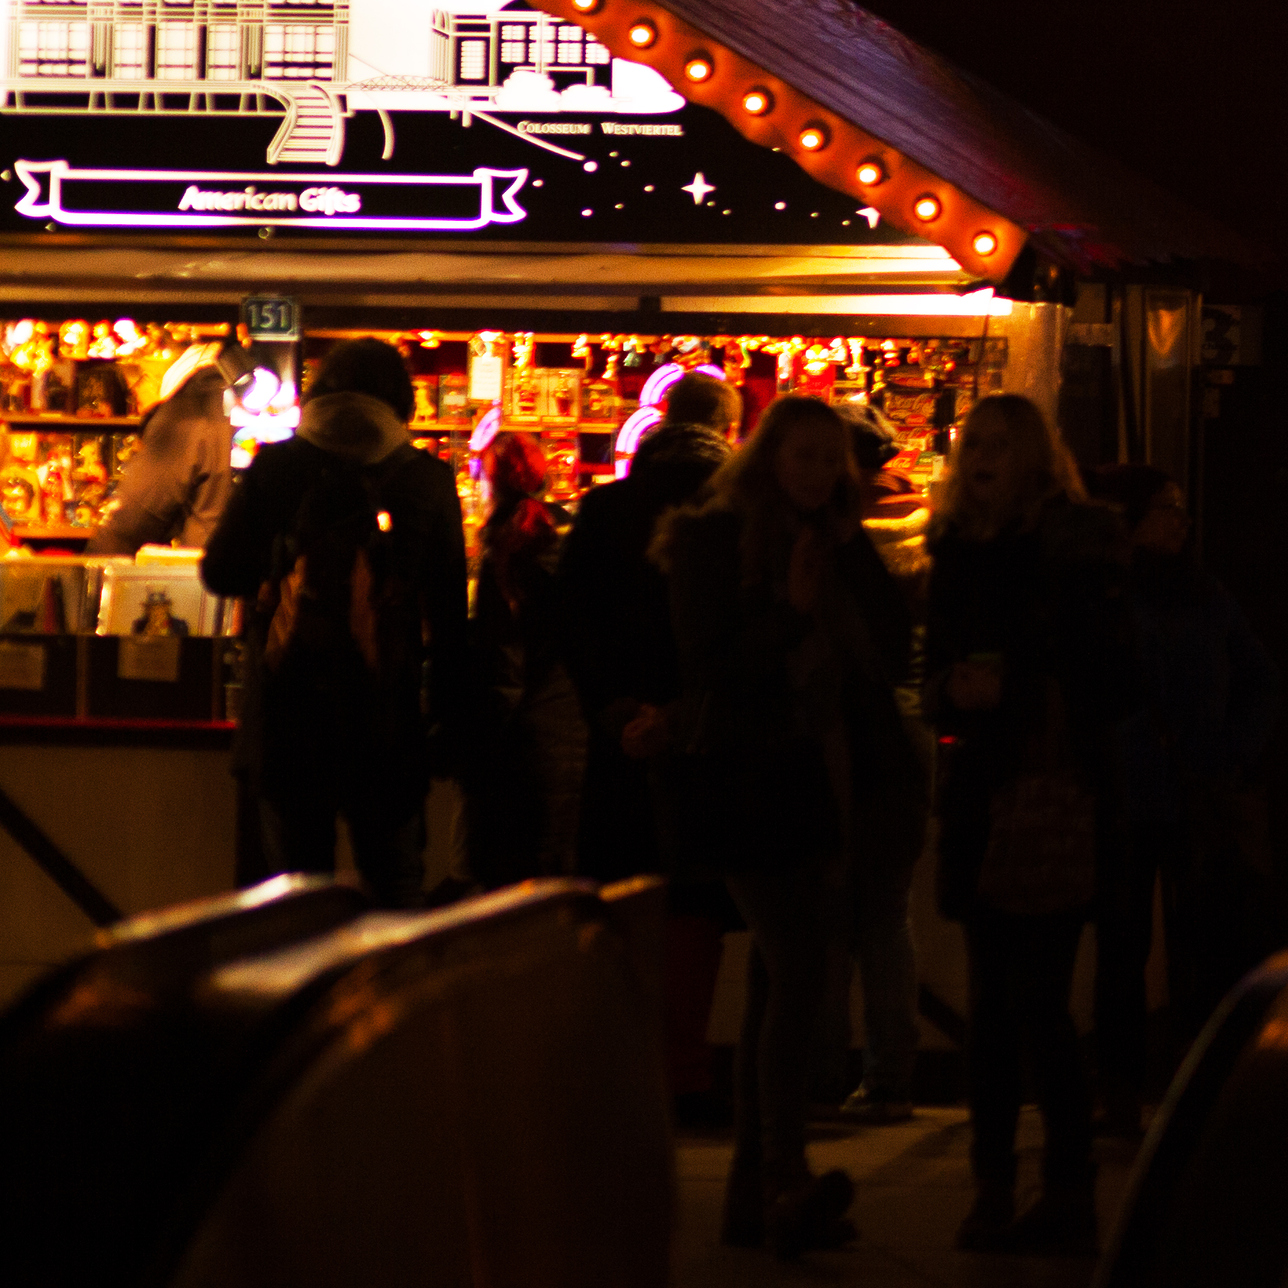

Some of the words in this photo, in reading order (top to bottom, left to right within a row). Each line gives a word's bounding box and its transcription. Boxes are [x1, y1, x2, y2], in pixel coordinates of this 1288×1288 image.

[177, 185, 298, 211] American
[298, 186, 361, 216] Gifts
[248, 304, 288, 329] 151
